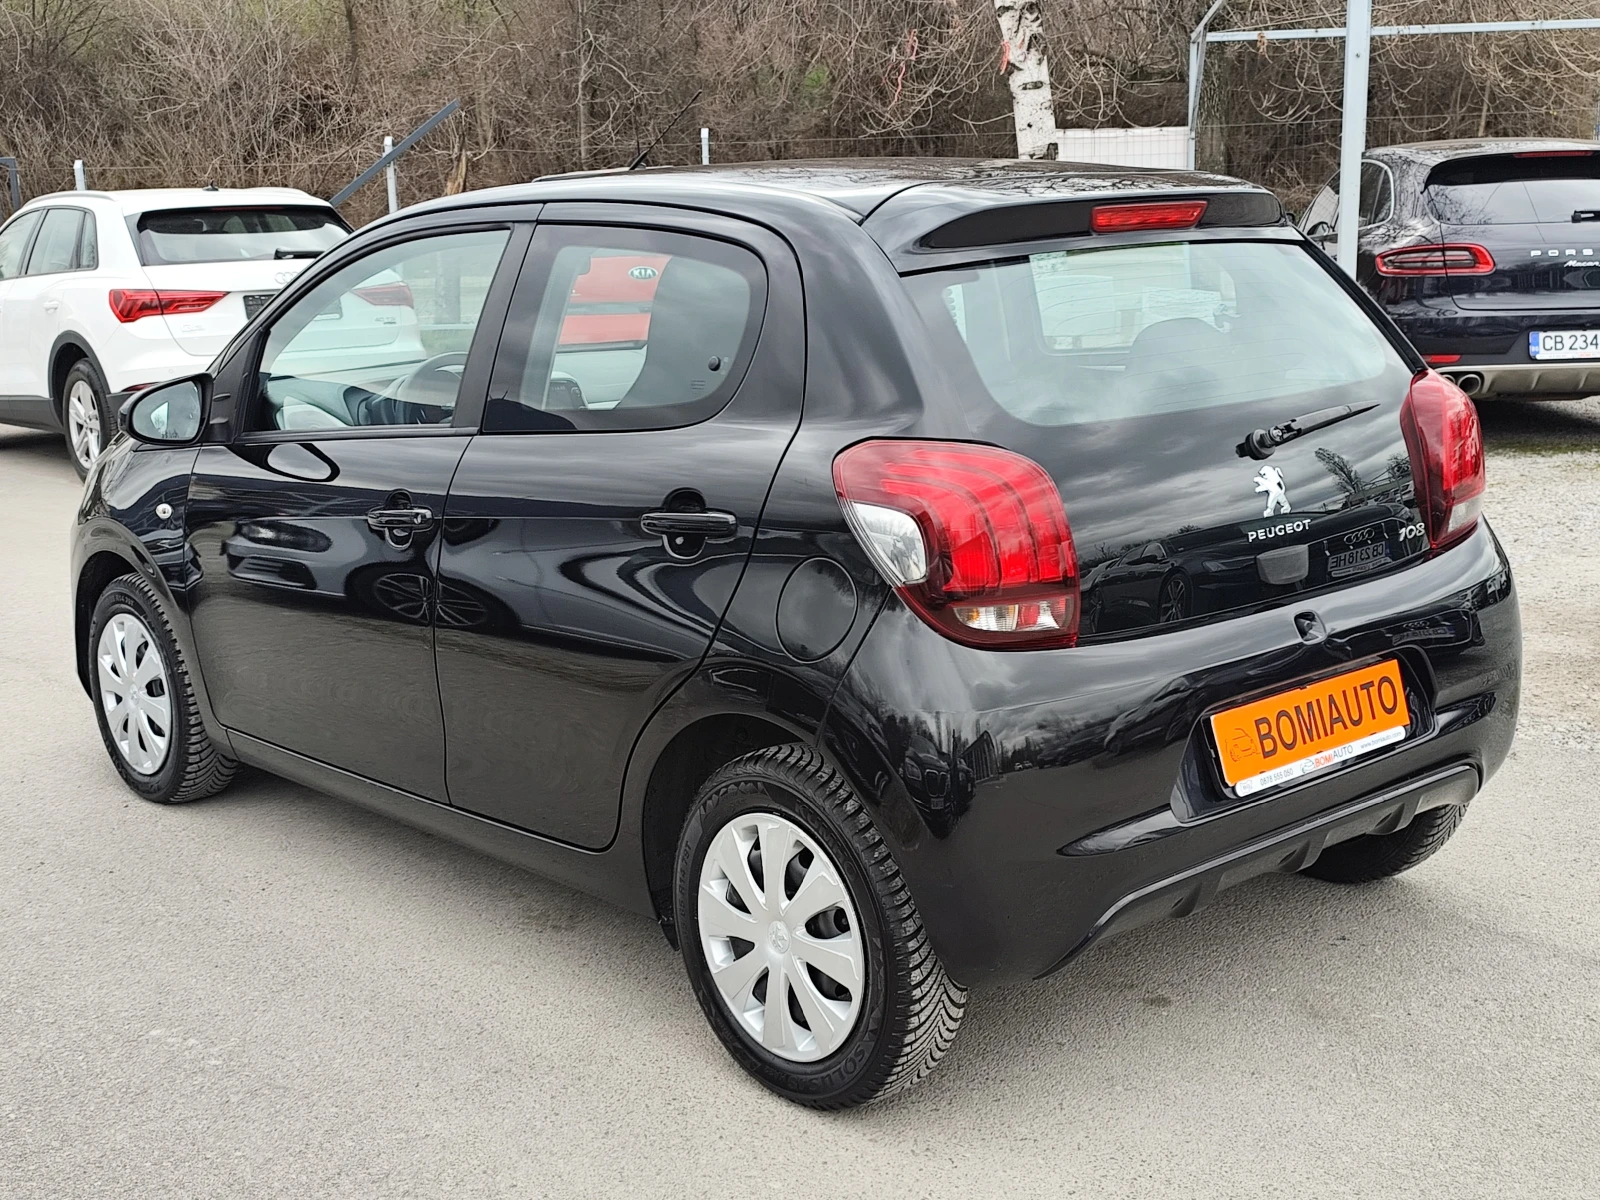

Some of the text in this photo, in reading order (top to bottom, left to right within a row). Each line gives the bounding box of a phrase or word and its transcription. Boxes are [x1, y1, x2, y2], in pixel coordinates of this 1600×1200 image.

[633, 269, 654, 278] KIA
[1542, 335, 1565, 351] CB
[1248, 519, 1312, 543] PEUGEOT
[1398, 522, 1426, 542] 108
[1255, 676, 1398, 759] BOMIAUTO
[1274, 772, 1284, 782] 555
[1284, 768, 1293, 778] 050
